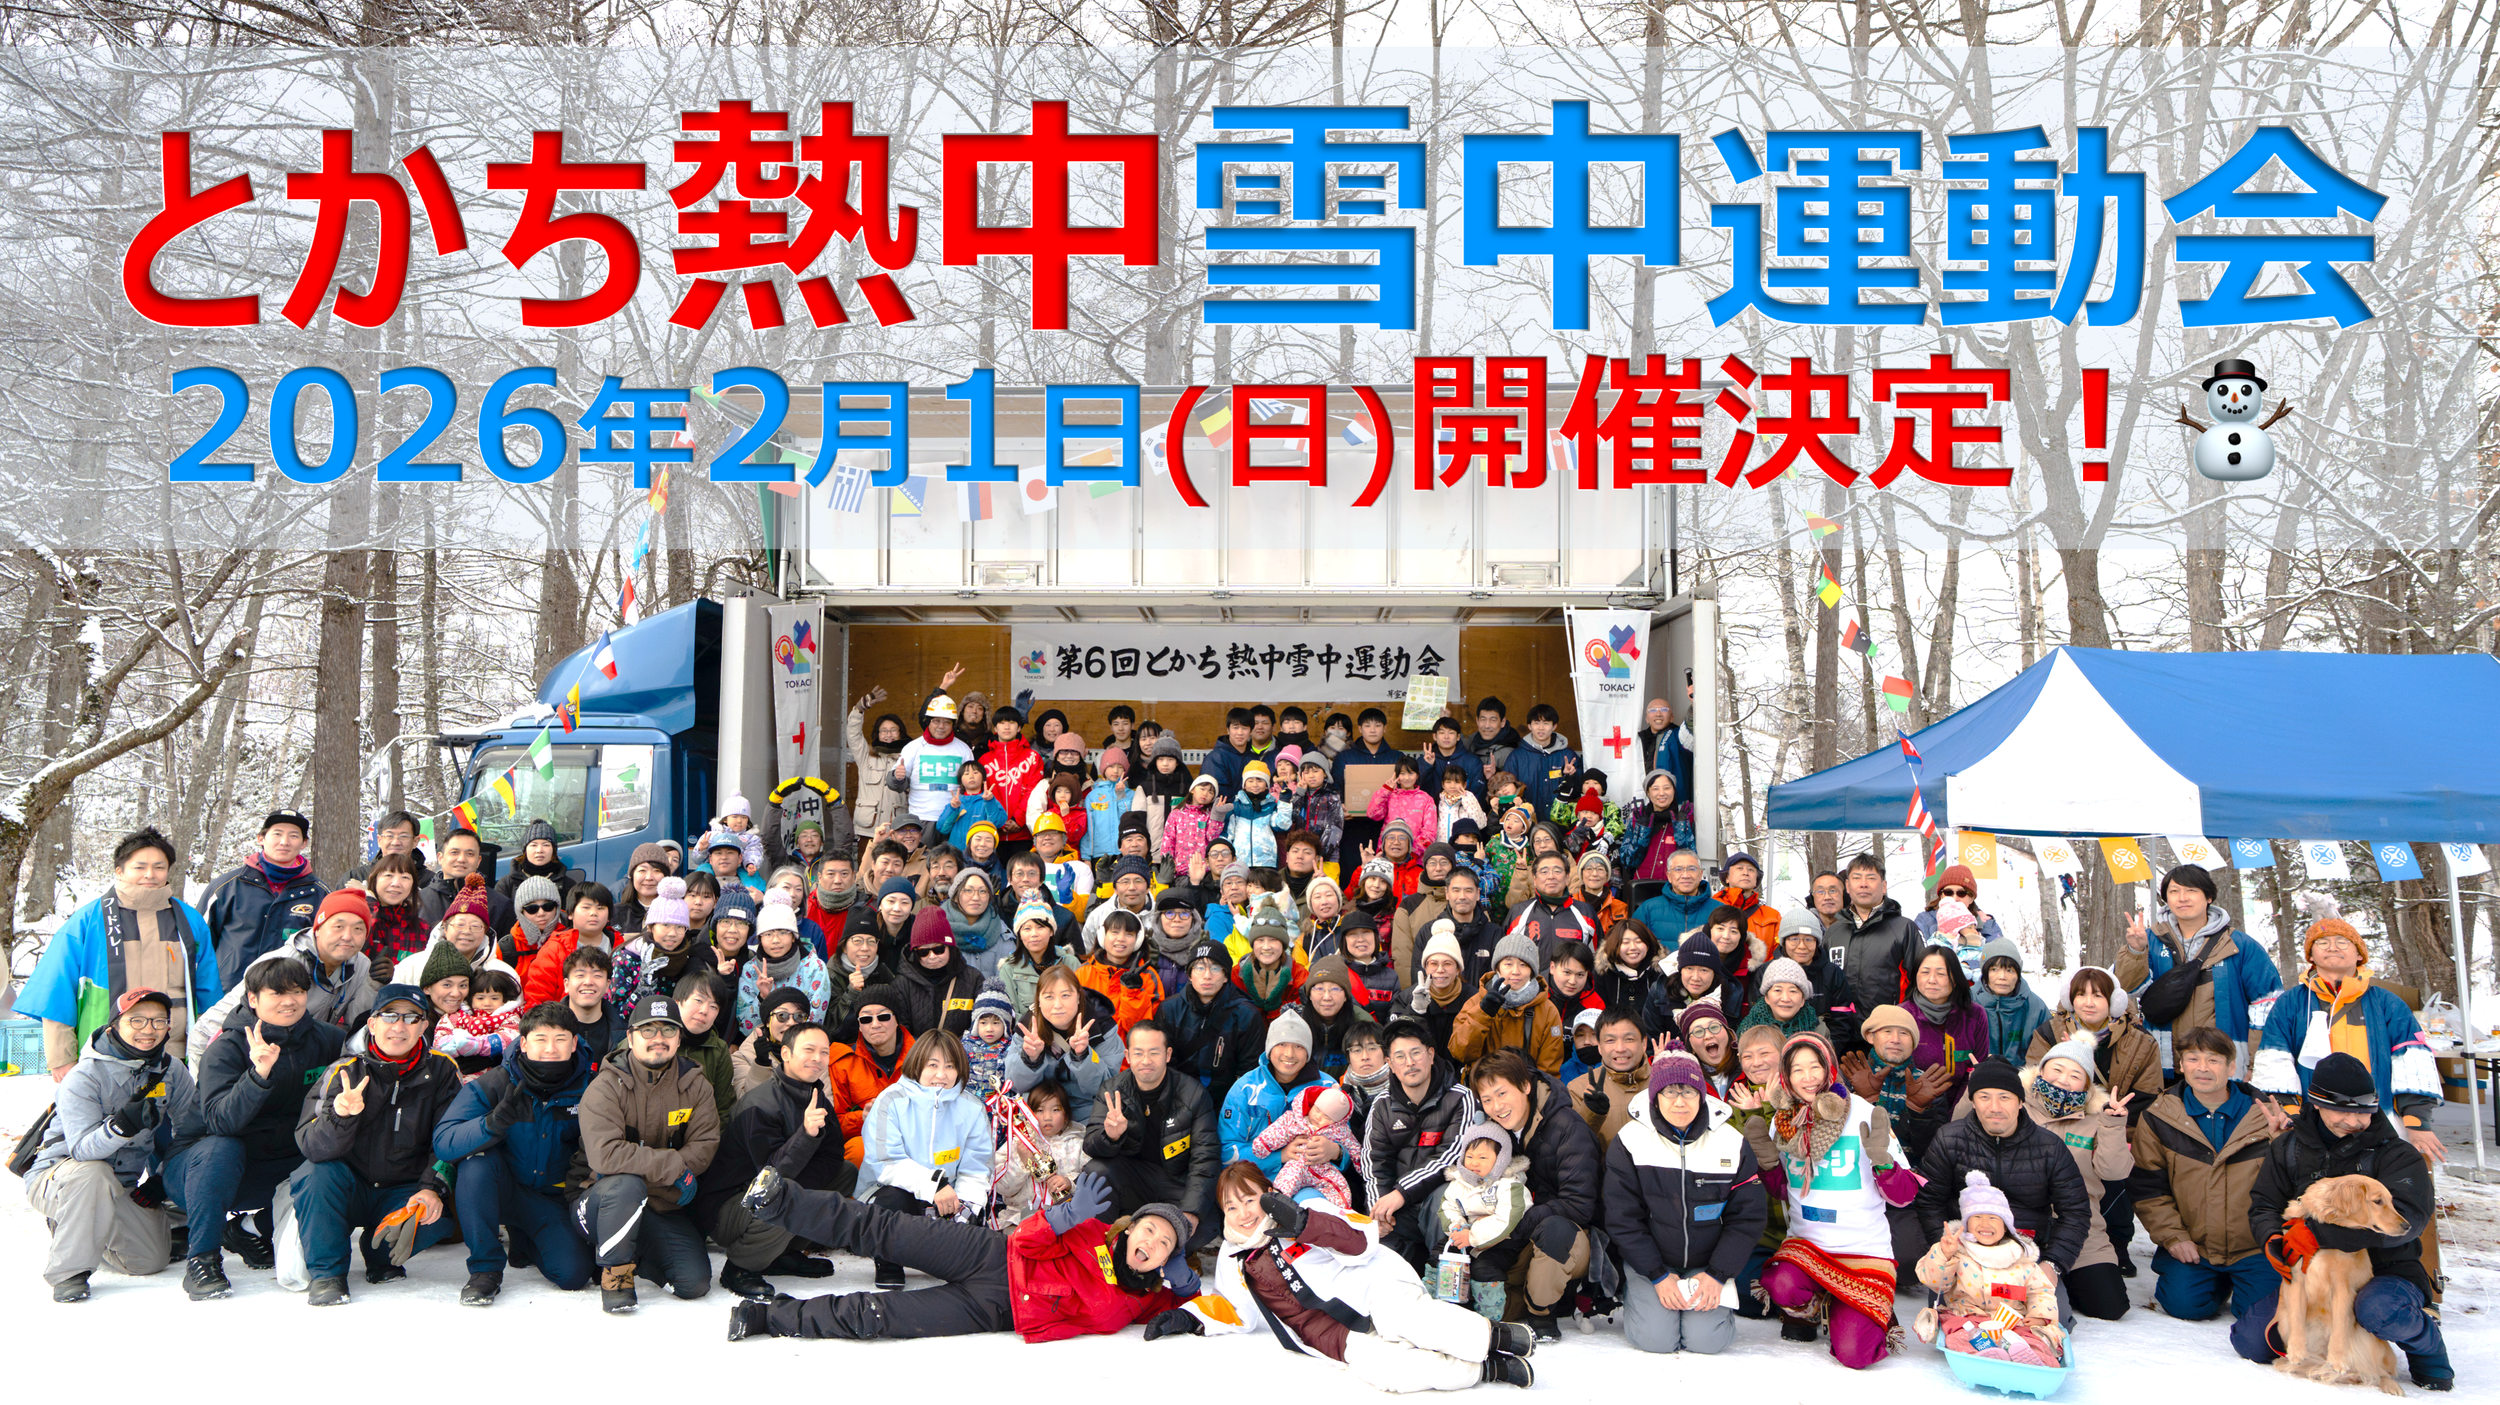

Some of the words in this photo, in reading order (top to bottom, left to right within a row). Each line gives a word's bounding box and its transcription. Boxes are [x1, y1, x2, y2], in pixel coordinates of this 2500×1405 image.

[1056, 642, 1446, 683] 第6回とかち熱中雪中運動会
[1599, 683, 1636, 692] TOKACH
[103, 897, 121, 956] フードバレー
